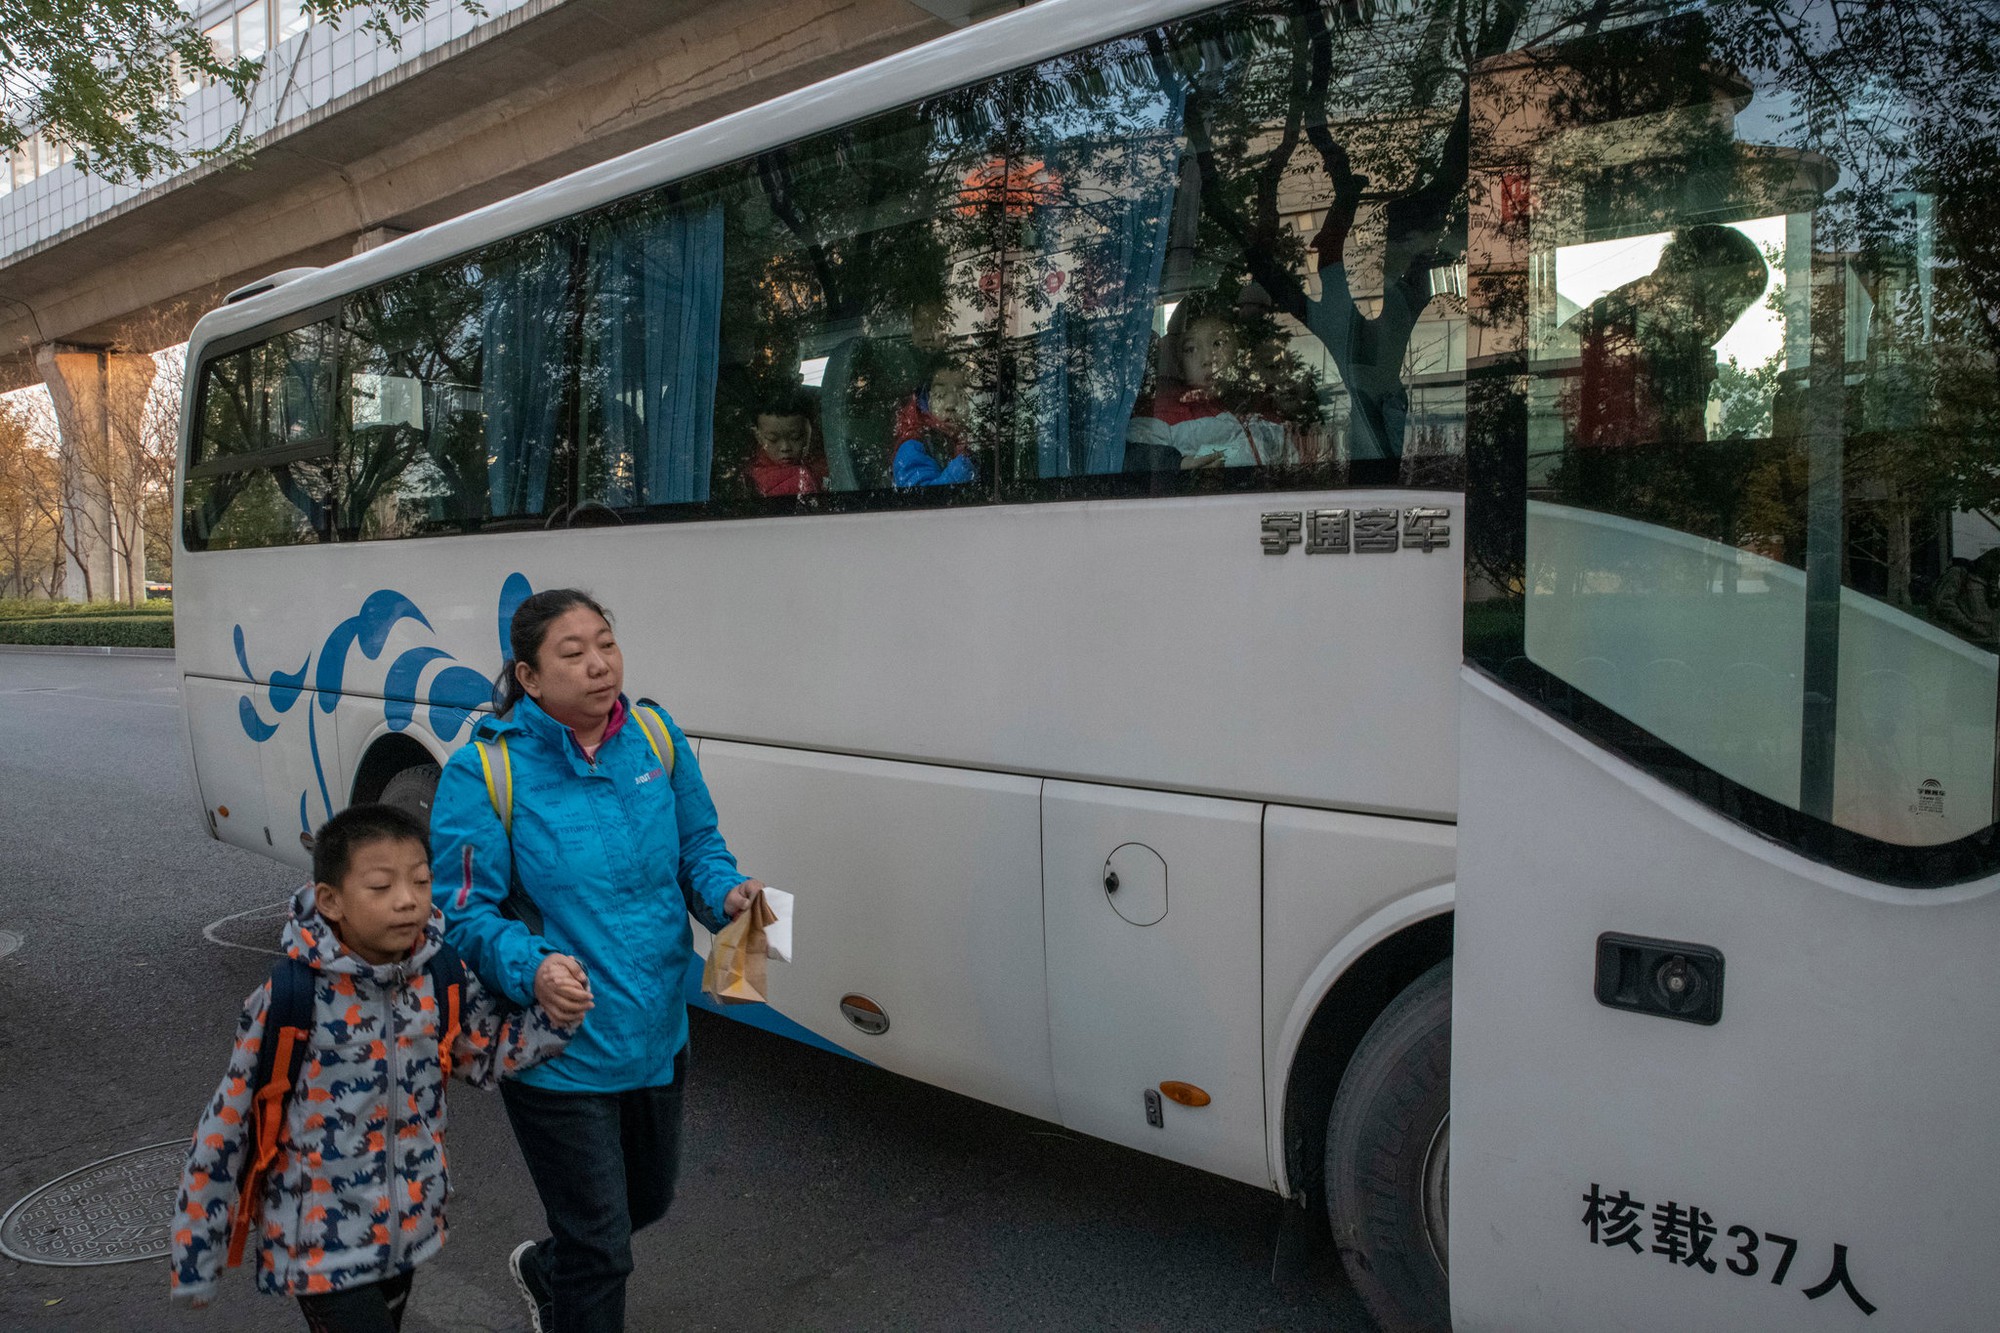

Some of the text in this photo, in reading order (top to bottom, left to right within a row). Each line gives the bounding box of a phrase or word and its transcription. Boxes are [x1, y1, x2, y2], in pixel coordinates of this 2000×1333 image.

[1260, 507, 1450, 555] 宇通客车
[1581, 1183, 1877, 1316] 核载37人
